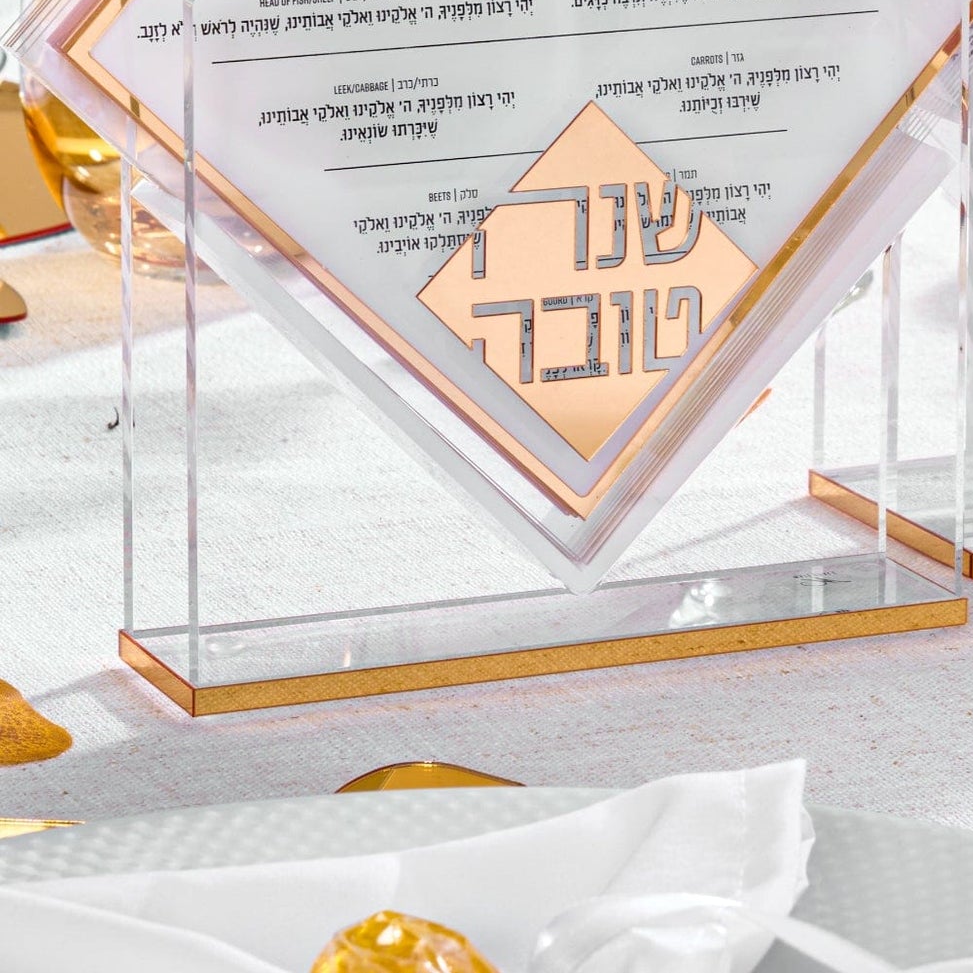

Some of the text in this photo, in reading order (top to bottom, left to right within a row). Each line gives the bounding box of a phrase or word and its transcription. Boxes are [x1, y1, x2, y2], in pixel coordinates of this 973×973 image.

[690, 53, 724, 67] CARROTS
[730, 52, 745, 63] גזר
[333, 80, 390, 96] LEEK/CABBAGE
[396, 77, 439, 91] כרתי/כרב
[677, 167, 699, 180] תמר
[428, 190, 452, 203] BEETS
[459, 188, 479, 202] סלק
[471, 181, 703, 280] שנה
[471, 285, 703, 384] טובה
